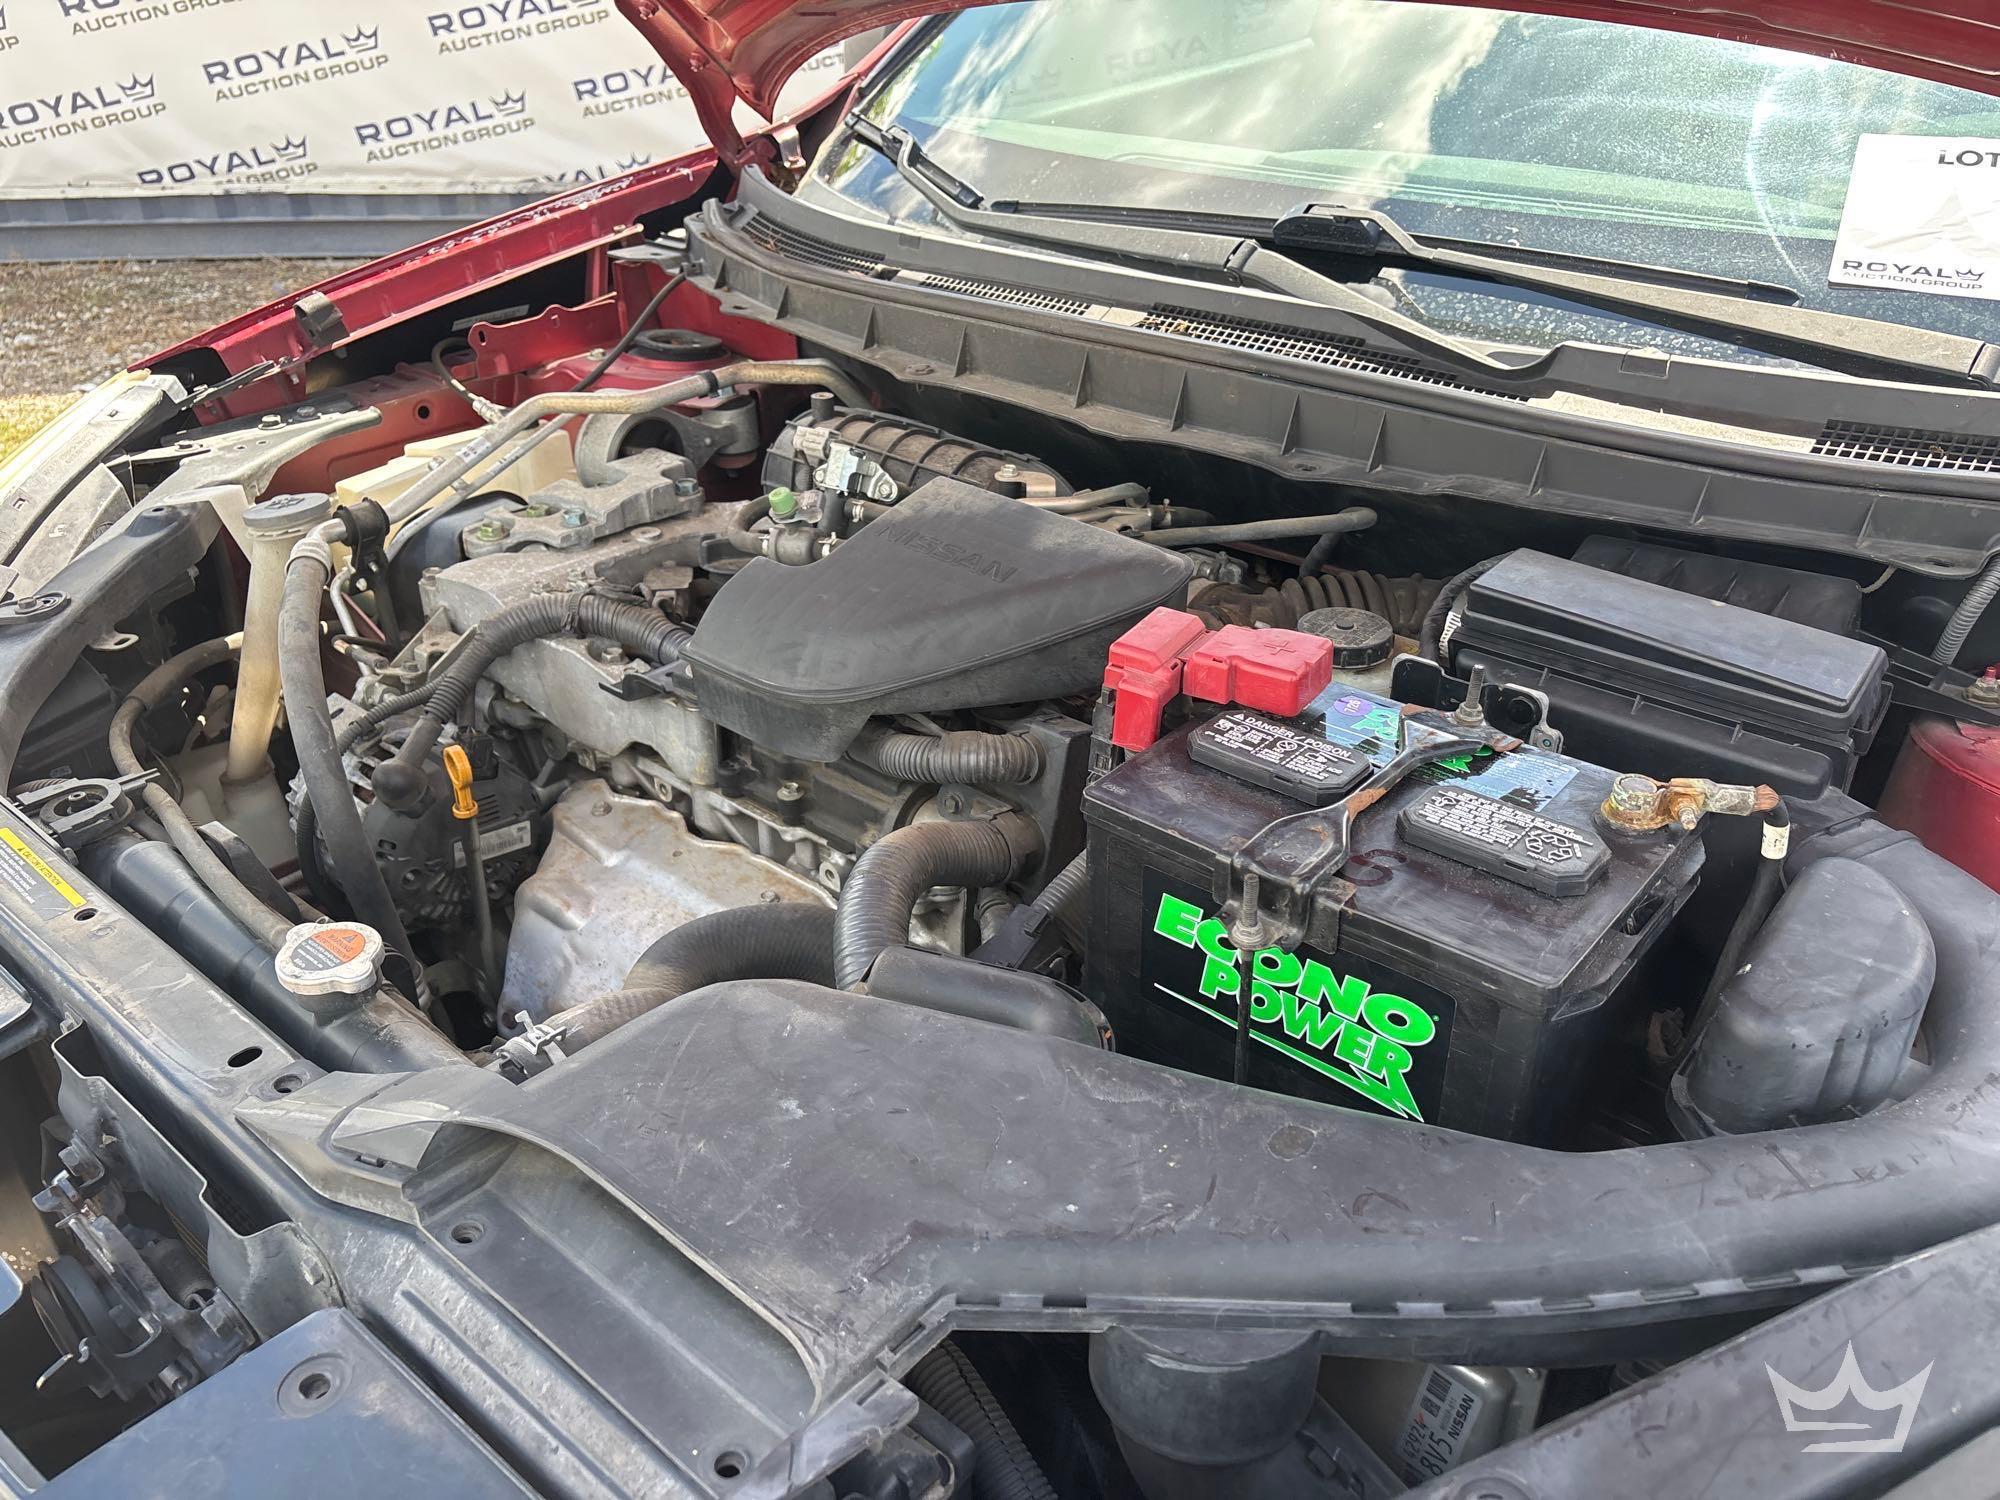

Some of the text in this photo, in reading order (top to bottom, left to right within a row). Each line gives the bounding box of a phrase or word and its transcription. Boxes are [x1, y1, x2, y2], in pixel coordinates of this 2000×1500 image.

[73, 4, 169, 35] AUCTION
[428, 0, 568, 36] ROYAL
[438, 9, 610, 55] AUCTION GROUP
[203, 38, 345, 84] ROYAL
[215, 54, 389, 103] AUCTION GROUP
[573, 64, 674, 101] ROYA
[91, 102, 167, 129] GROUP
[355, 101, 493, 145] ROYAL
[582, 88, 673, 119] AUCTION
[366, 117, 536, 163] AUCTION GROUP
[1938, 150, 2000, 167] LOT
[1842, 260, 1953, 279] ROYAL
[1843, 271, 1983, 290] AUCTION GROUP
[876, 522, 1019, 584] NISSAN
[1245, 716, 1295, 738] DANGER
[1303, 738, 1352, 758] POISON
[1153, 892, 1436, 1046] ECONO
[1199, 954, 1415, 1083] POWER
[1447, 1393, 1475, 1441] NISSAN
